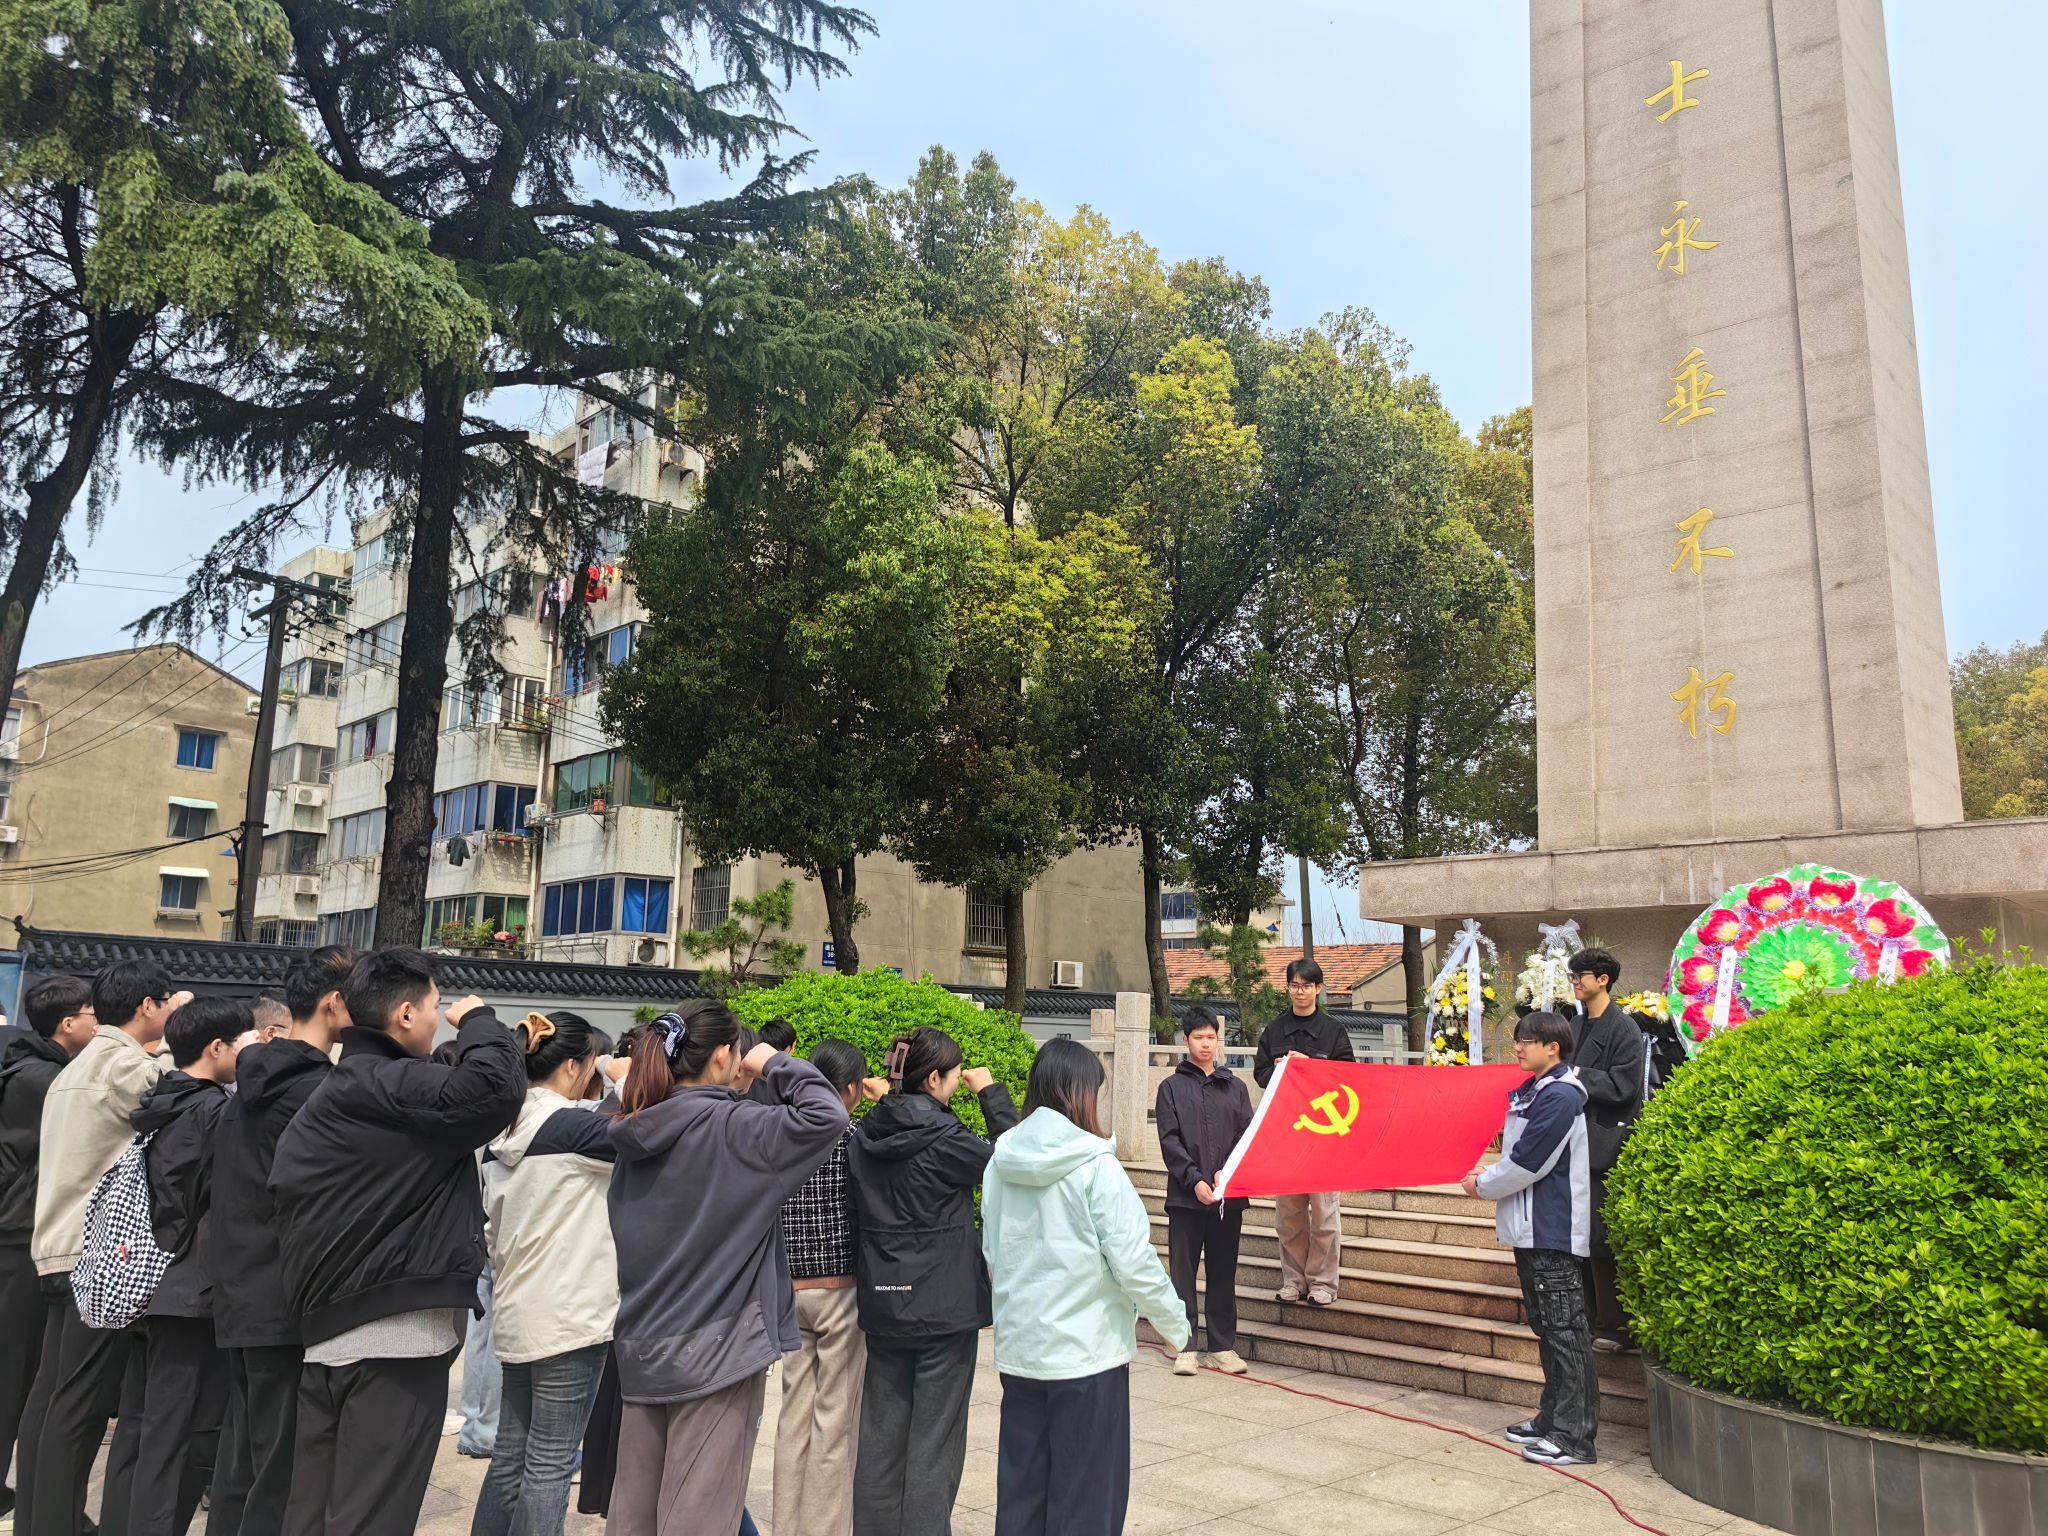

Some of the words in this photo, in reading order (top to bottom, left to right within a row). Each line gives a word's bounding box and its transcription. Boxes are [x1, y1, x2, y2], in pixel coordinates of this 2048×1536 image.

[1644, 59, 1738, 739] 士永垂不朽
